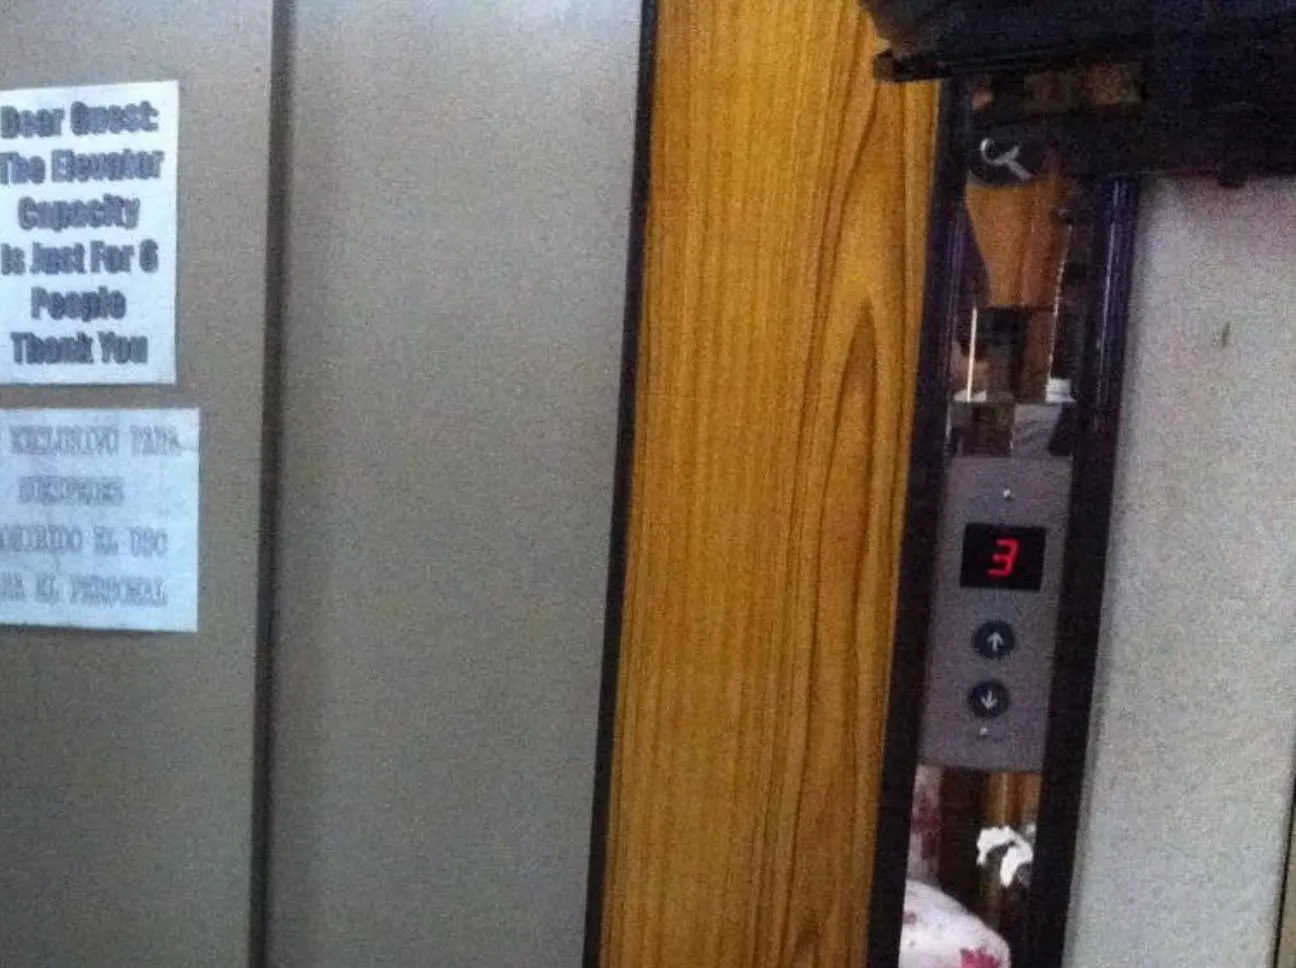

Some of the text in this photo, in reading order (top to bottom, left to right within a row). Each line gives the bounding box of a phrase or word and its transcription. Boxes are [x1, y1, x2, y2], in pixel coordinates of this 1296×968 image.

[0, 105, 65, 139] Dear
[51, 149, 165, 182] Elevator
[17, 193, 141, 232] Capacity
[0, 238, 159, 275] Is Just For 6
[31, 286, 127, 322] People
[10, 331, 149, 364] Thank You
[988, 537, 1021, 577] 3
